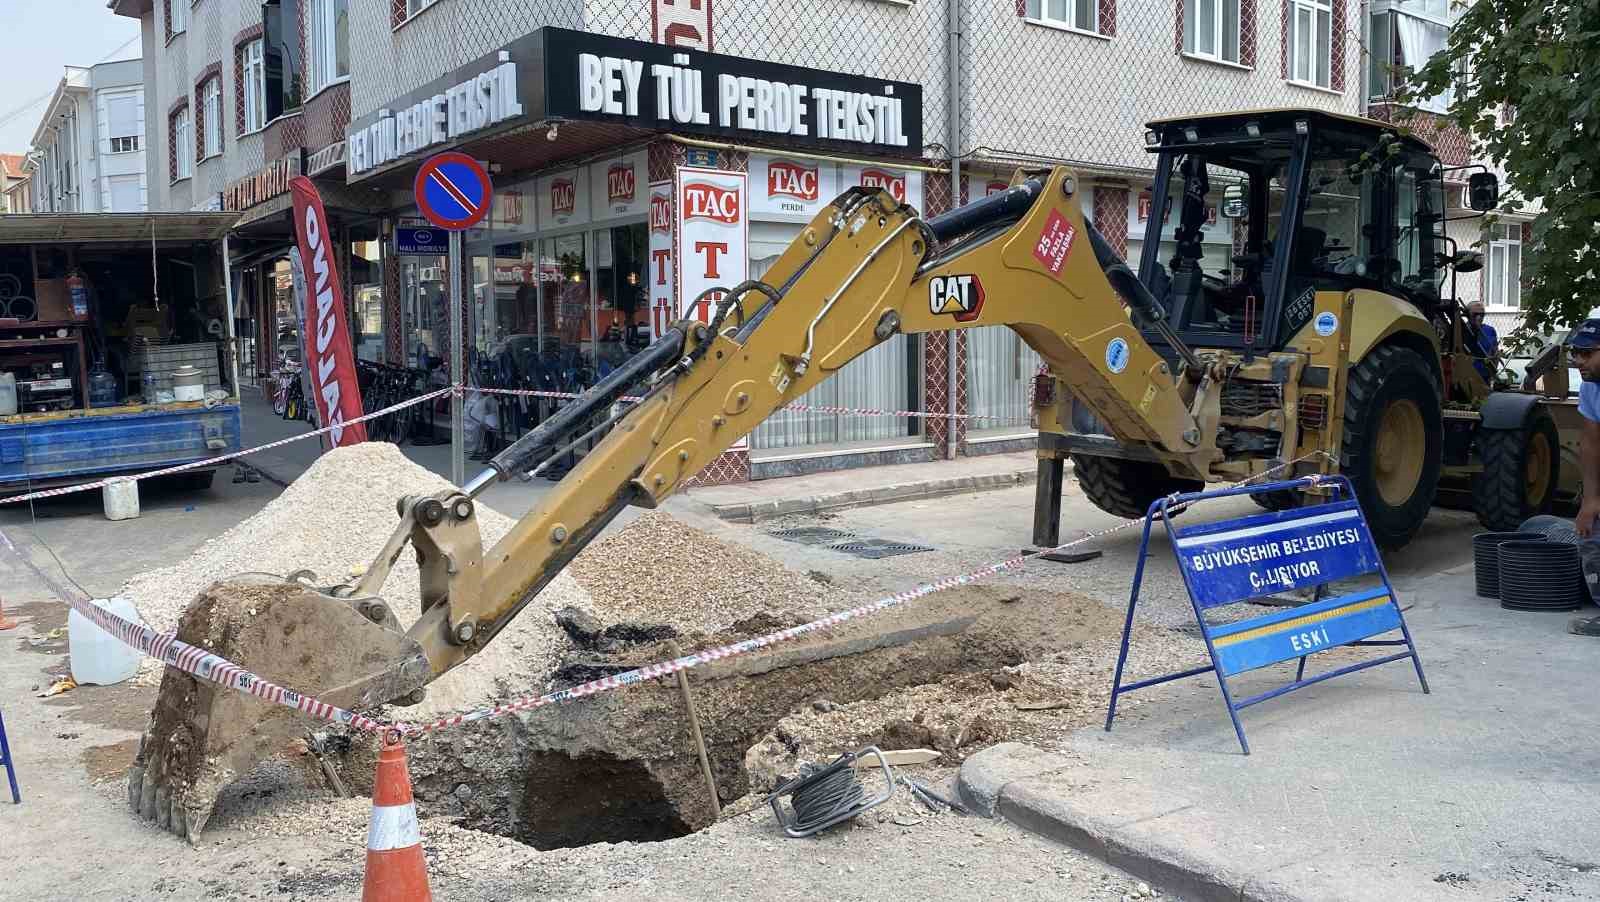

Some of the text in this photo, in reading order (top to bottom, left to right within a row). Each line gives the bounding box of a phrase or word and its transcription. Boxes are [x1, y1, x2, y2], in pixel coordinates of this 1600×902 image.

[396, 94, 447, 156] PERDE
[446, 51, 523, 138] TEKSTİL
[579, 53, 908, 146] BEY TÜL PERDE TEKSTİL
[771, 168, 816, 199] TAÇ
[687, 189, 736, 222] TAÇ
[1038, 235, 1050, 256] 25
[931, 275, 971, 313] CAT
[1193, 539, 1281, 571] BÜYÜKŞEHİR
[1290, 625, 1329, 651] ESKİ
